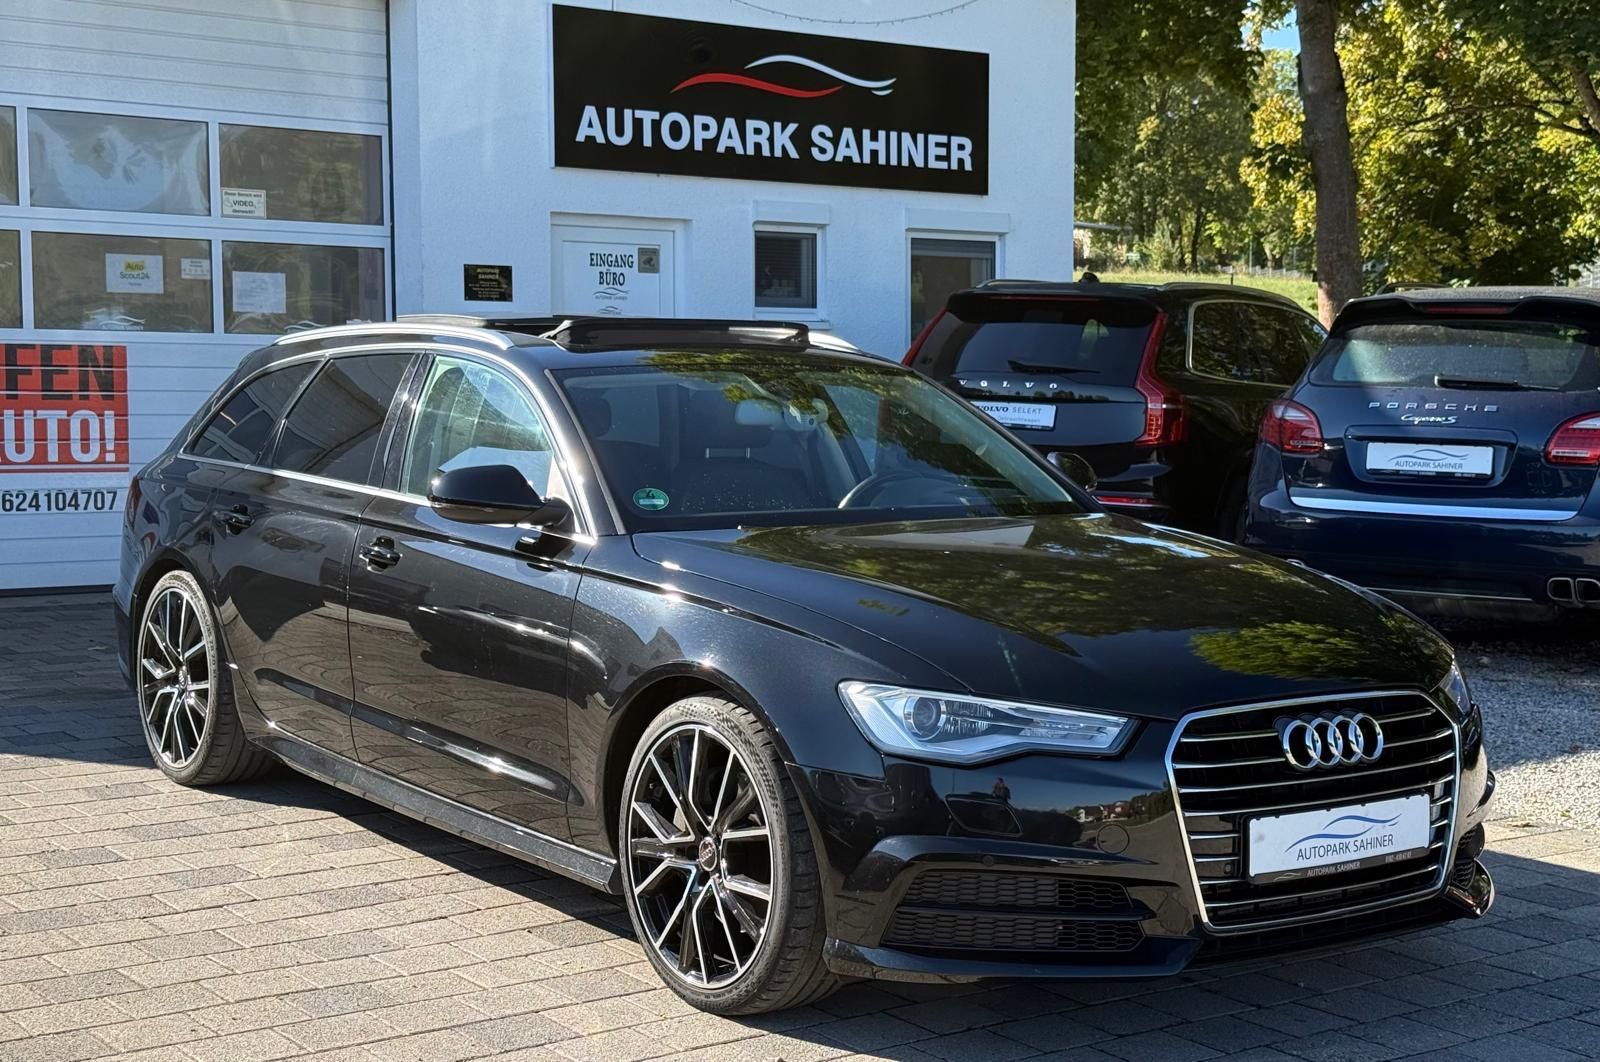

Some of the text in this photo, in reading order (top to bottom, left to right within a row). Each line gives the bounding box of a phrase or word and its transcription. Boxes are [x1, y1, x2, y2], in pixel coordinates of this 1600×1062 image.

[576, 105, 973, 171] AUTOPARK SAHINER
[232, 199, 254, 207] VIDEO
[589, 252, 634, 269] EINGANG
[125, 262, 144, 271] Auto
[120, 271, 150, 280] Scout24
[598, 268, 626, 287] BÜRO
[958, 379, 1058, 389] VOLVO
[1011, 406, 1042, 415] SELEKT
[1368, 402, 1498, 412] PORSCHE
[0, 410, 116, 463] UTO!
[1395, 460, 1463, 470] AUTOPARK SAHINER
[1296, 834, 1394, 861] AUTOPARK SAHINER
[1307, 861, 1360, 877] AUTOPARK SAHINER
